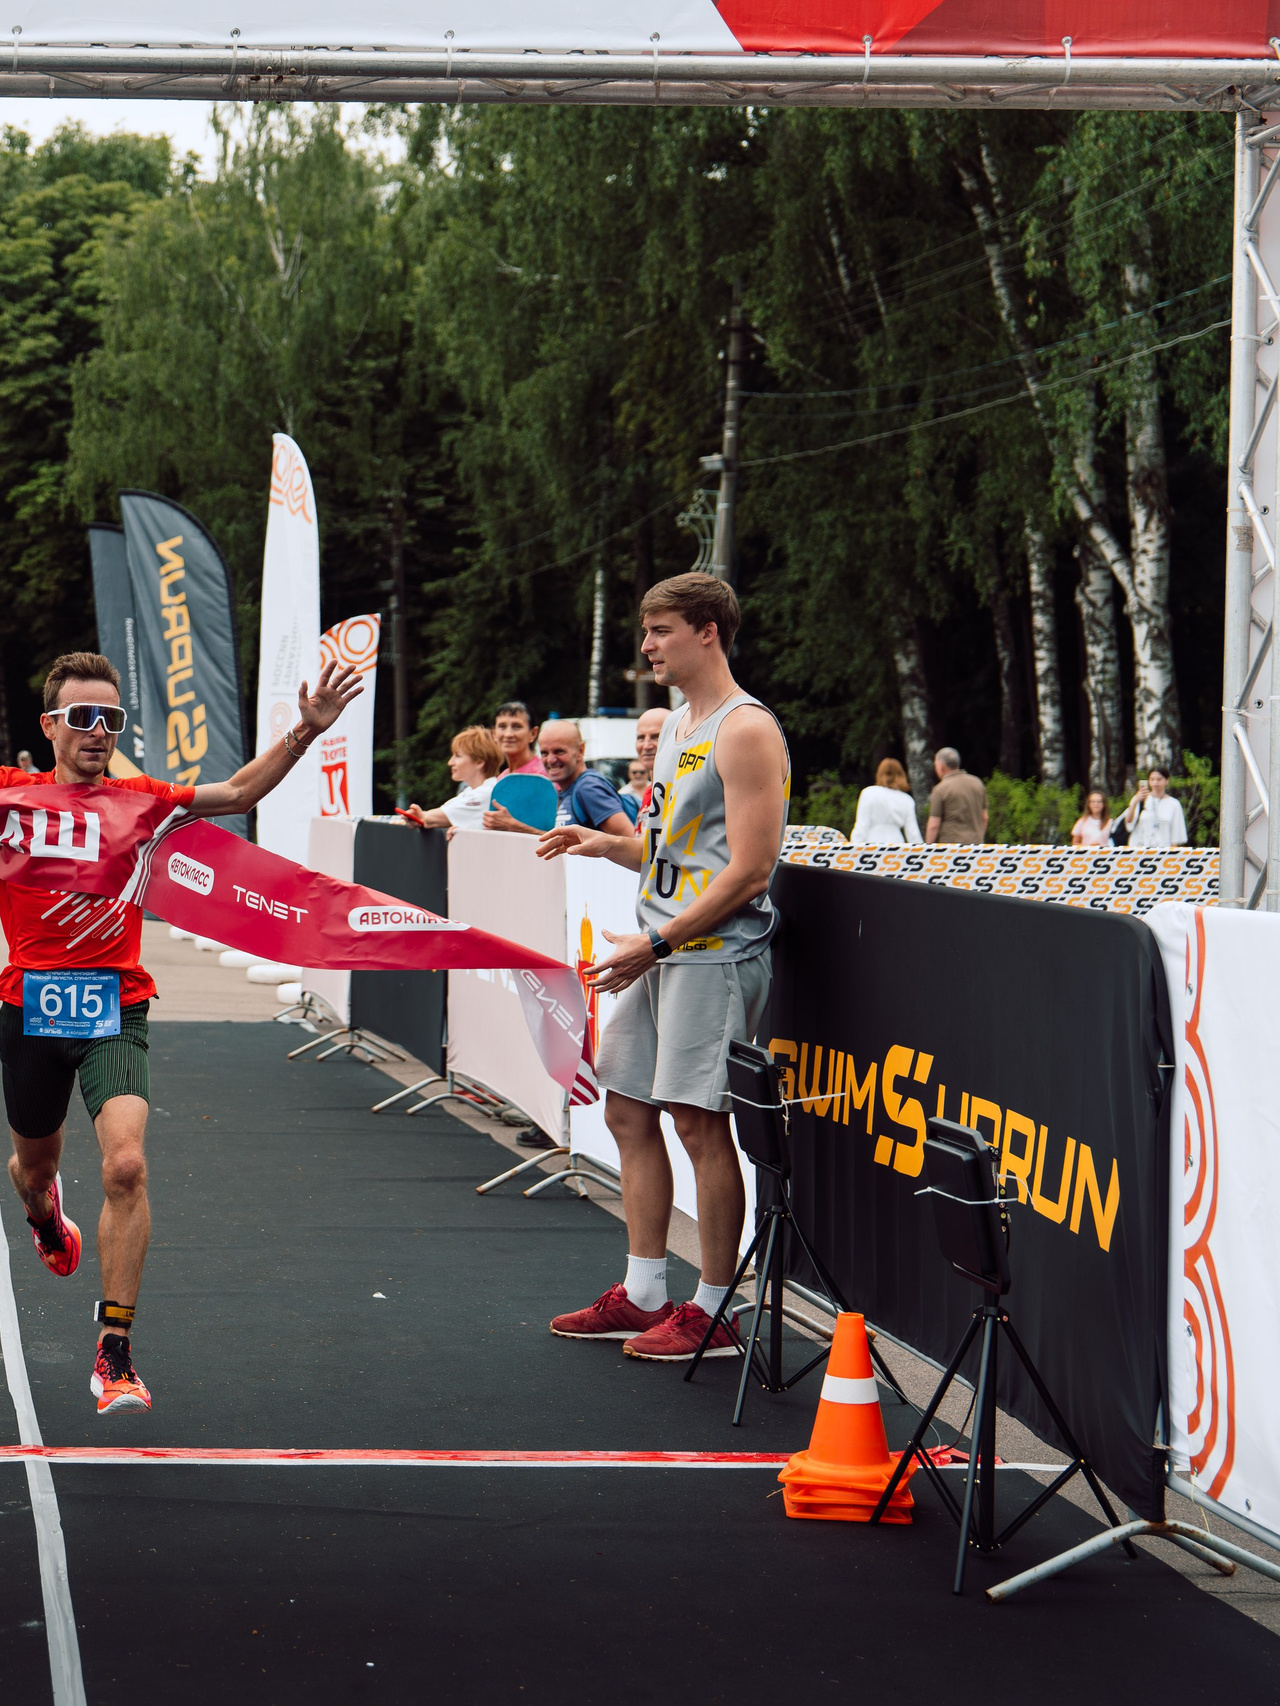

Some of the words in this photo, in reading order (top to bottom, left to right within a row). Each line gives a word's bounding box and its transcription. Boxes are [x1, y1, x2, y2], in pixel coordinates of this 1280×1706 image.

[678, 752, 705, 772] ОРГ
[170, 858, 210, 888] АВТОКЛАСС
[232, 884, 309, 923] TENET
[359, 911, 462, 926] АВТОКЛА
[39, 983, 103, 1018] 615
